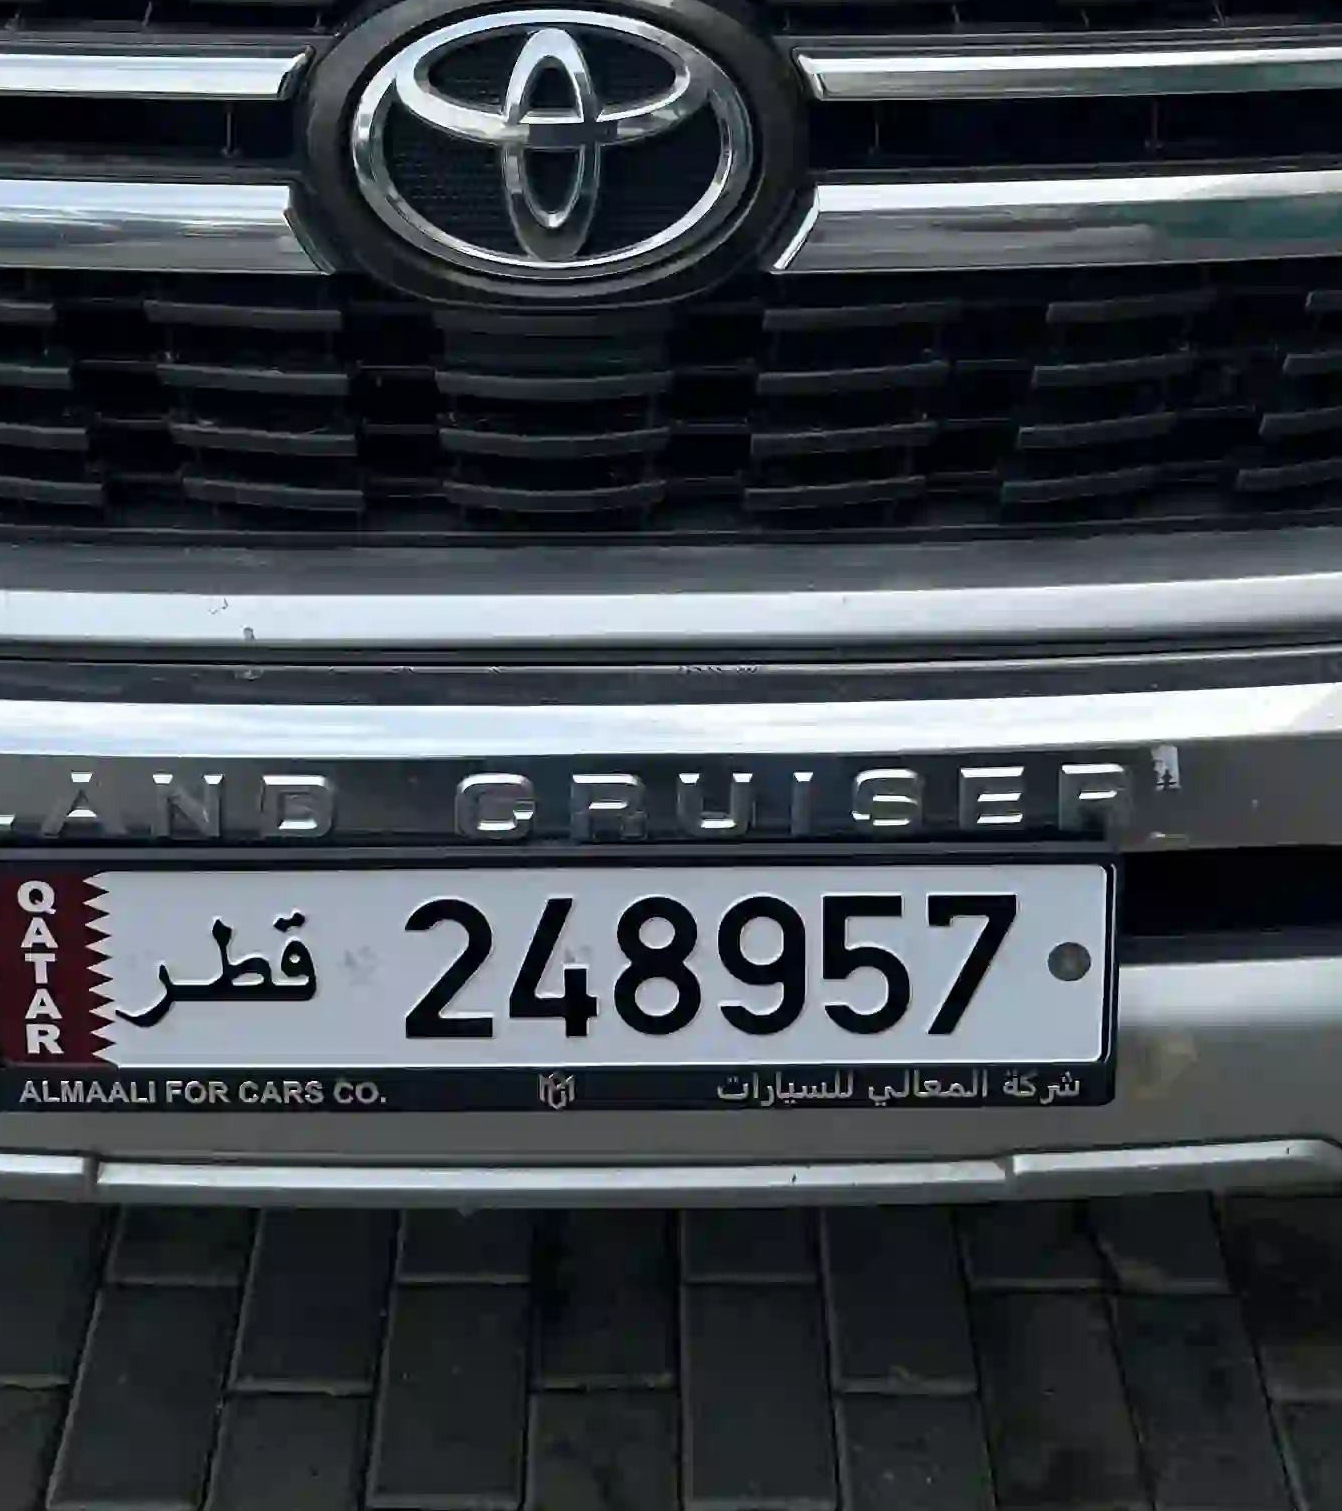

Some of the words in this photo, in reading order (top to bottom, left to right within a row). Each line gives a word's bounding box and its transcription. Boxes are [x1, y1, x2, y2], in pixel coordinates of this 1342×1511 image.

[456, 764, 1133, 840] CRUISER
[17, 880, 65, 1054] QATAR
[115, 910, 317, 1027] قطر
[404, 894, 1018, 1040] 248957
[19, 1080, 156, 1104] ALMAALI
[166, 1080, 230, 1103] FOR
[238, 1080, 324, 1104] CARS
[333, 1080, 387, 1104] CO.
[717, 1068, 854, 1107] للسيارات
[868, 1068, 989, 1107] المعالي
[1002, 1069, 1081, 1105] شركة
